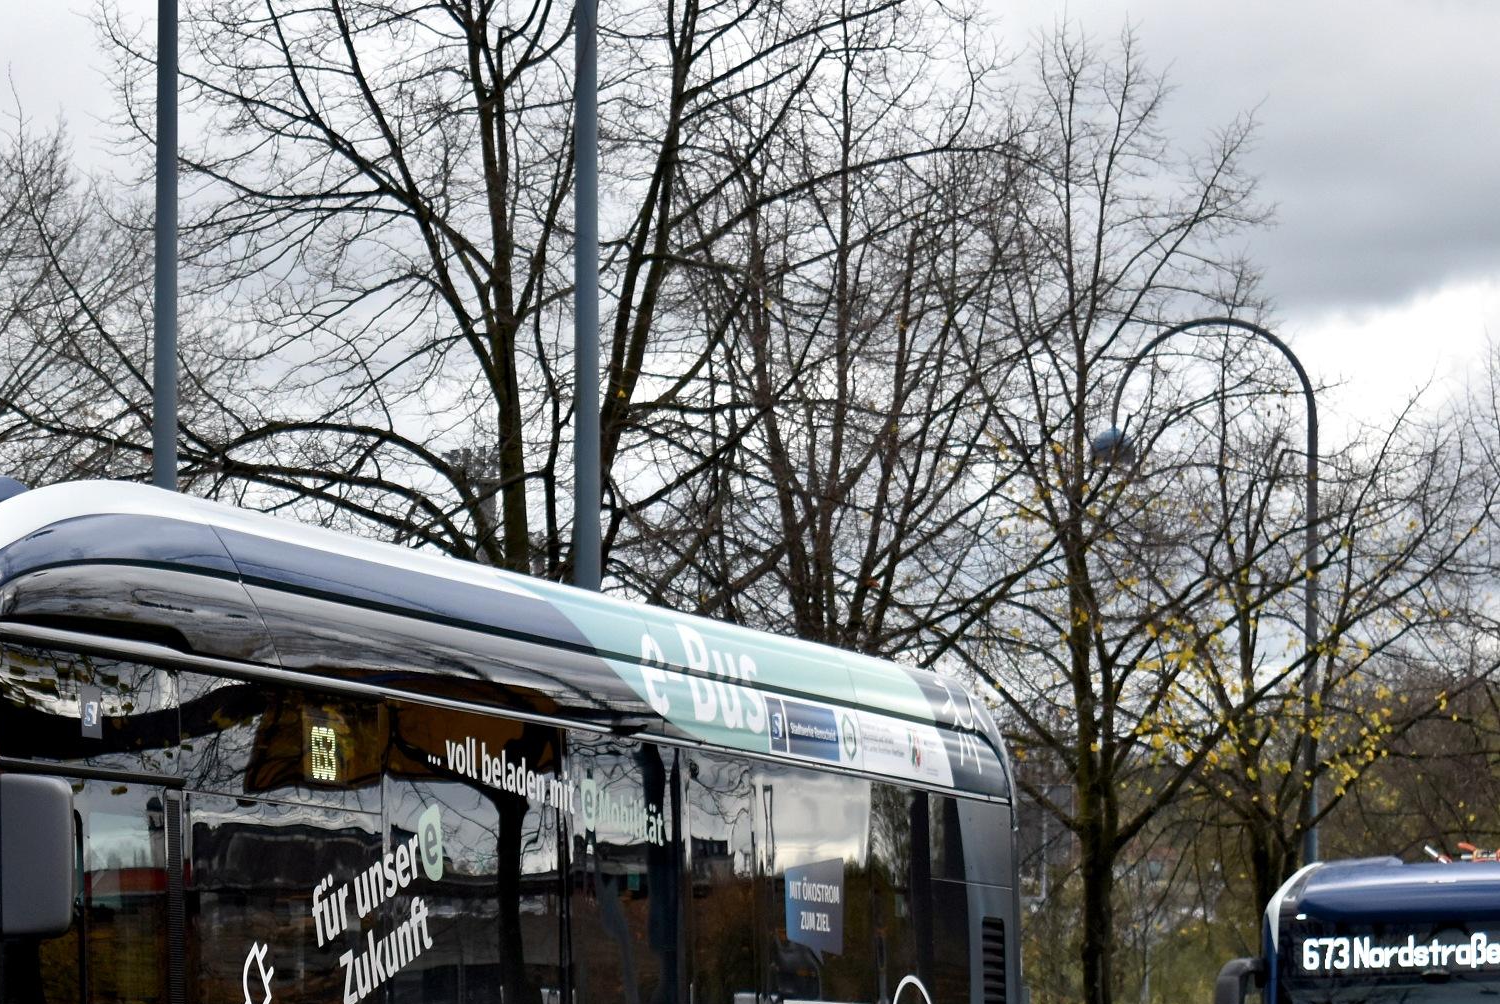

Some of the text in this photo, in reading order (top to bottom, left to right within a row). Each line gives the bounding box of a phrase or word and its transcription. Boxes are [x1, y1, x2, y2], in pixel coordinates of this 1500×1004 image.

[311, 727, 336, 781] 653
[446, 736, 478, 779] voll
[481, 742, 545, 803] beladen
[549, 771, 575, 814] mit
[312, 873, 349, 948] für
[789, 876, 840, 904] MIT ÖKOSTROM
[800, 911, 831, 933] ZUM ZIEL
[1302, 932, 1500, 970] 673 Nordstraße
